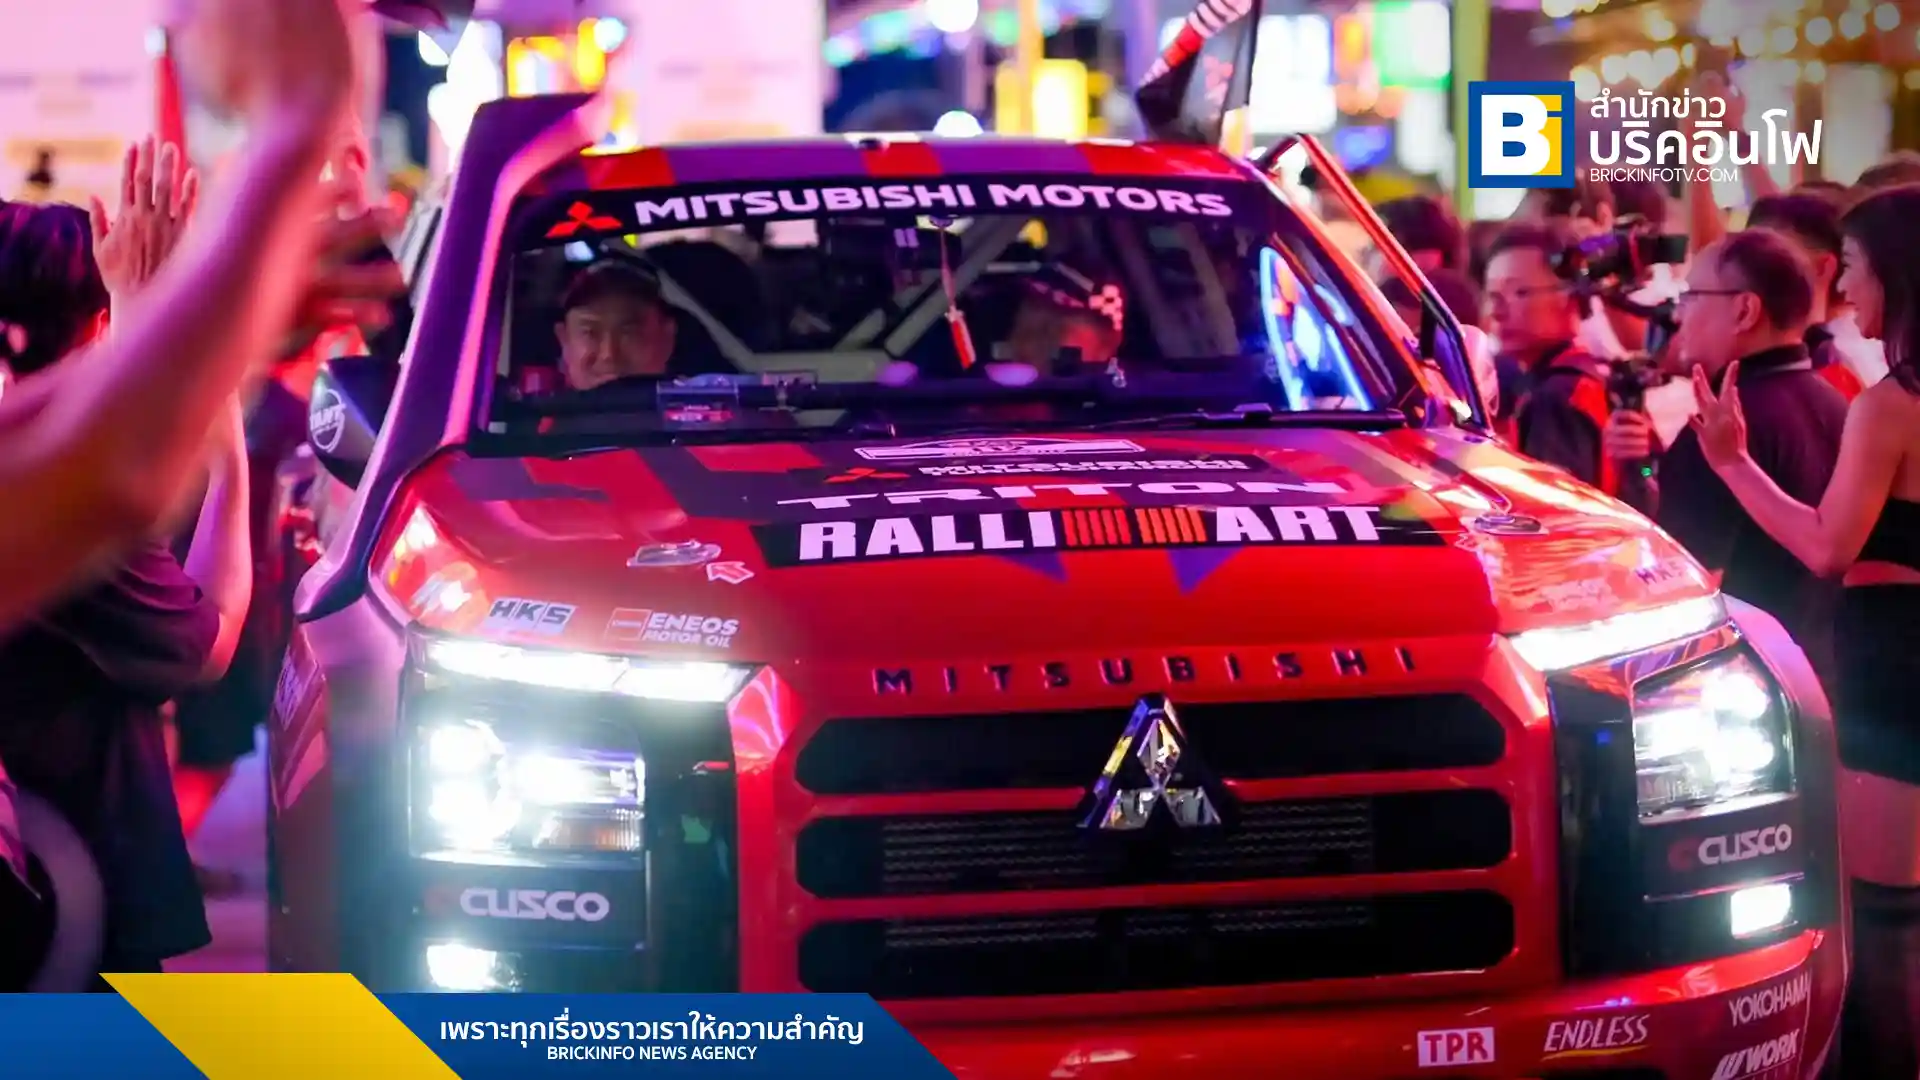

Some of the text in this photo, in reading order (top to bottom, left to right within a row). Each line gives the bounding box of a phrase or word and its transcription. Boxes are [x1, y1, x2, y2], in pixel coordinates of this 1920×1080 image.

[634, 184, 1234, 225] MITSUBISHI MOTORS
[777, 481, 1349, 509] TRITON
[488, 600, 571, 625] HKS
[646, 612, 739, 636] ENEOS
[642, 629, 732, 648] MOTOR OIL
[872, 646, 1415, 696] MITSUBISHI
[1698, 823, 1792, 865] CUSCO
[459, 887, 610, 922] CUSCO
[1424, 1031, 1489, 1063] TPR
[1544, 1014, 1651, 1052] ENDLESS
